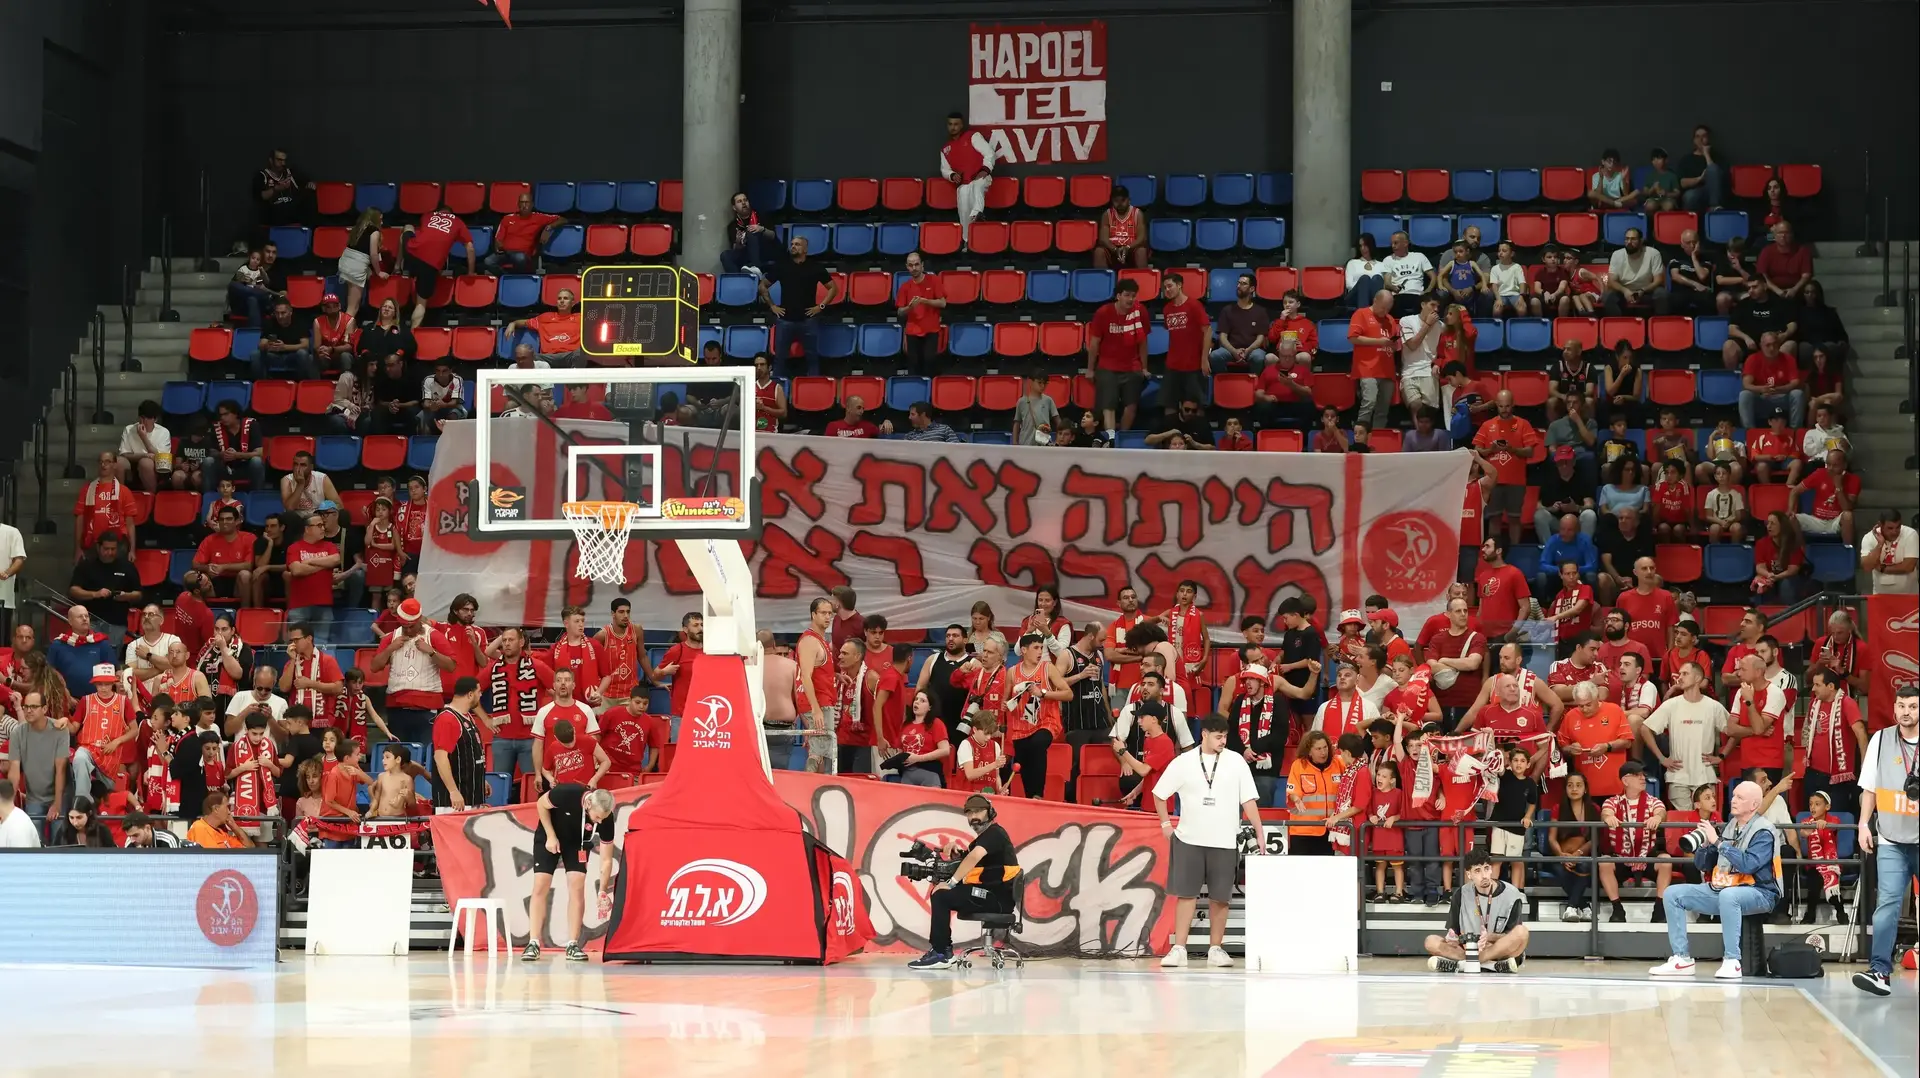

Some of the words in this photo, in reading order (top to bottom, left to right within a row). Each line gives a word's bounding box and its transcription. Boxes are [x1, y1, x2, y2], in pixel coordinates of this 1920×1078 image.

[971, 30, 1104, 79] HAPOEL
[994, 85, 1087, 121] TEL
[989, 124, 1100, 164] AVIV
[427, 216, 453, 234] 22
[184, 447, 206, 458] MARVEL
[847, 453, 1042, 538] זאת
[1061, 464, 1336, 556] הייתה
[1631, 620, 1661, 631] EPSON
[518, 658, 536, 681] אב
[491, 654, 508, 712] דומה!
[520, 689, 537, 712] תל
[101, 718, 109, 729] 2
[693, 725, 731, 739] הפועל
[240, 773, 253, 800] VIV
[366, 834, 407, 850] A6
